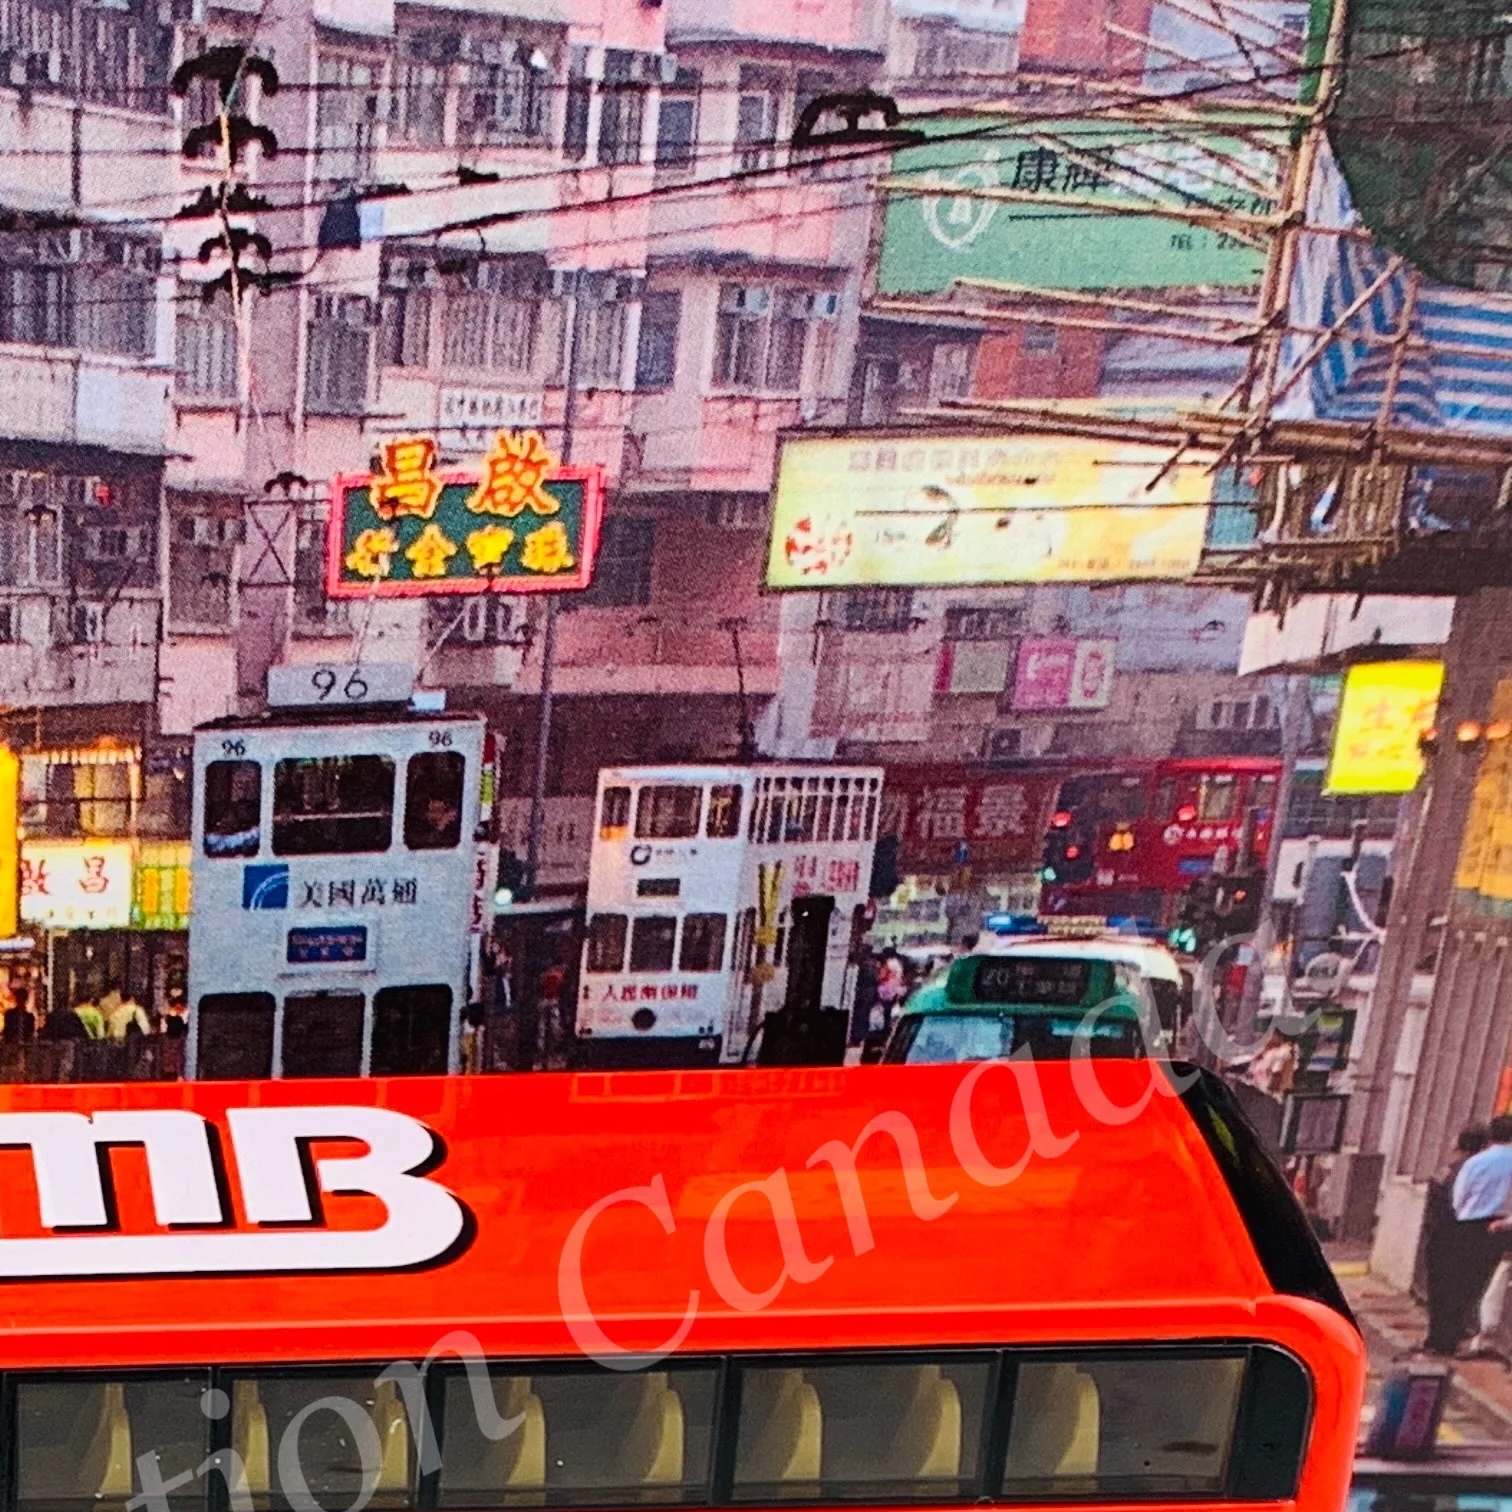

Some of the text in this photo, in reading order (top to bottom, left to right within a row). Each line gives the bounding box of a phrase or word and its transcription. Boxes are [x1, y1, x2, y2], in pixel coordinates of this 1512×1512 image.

[310, 668, 369, 700] 96
[222, 739, 247, 757] 96
[428, 730, 453, 748] 96
